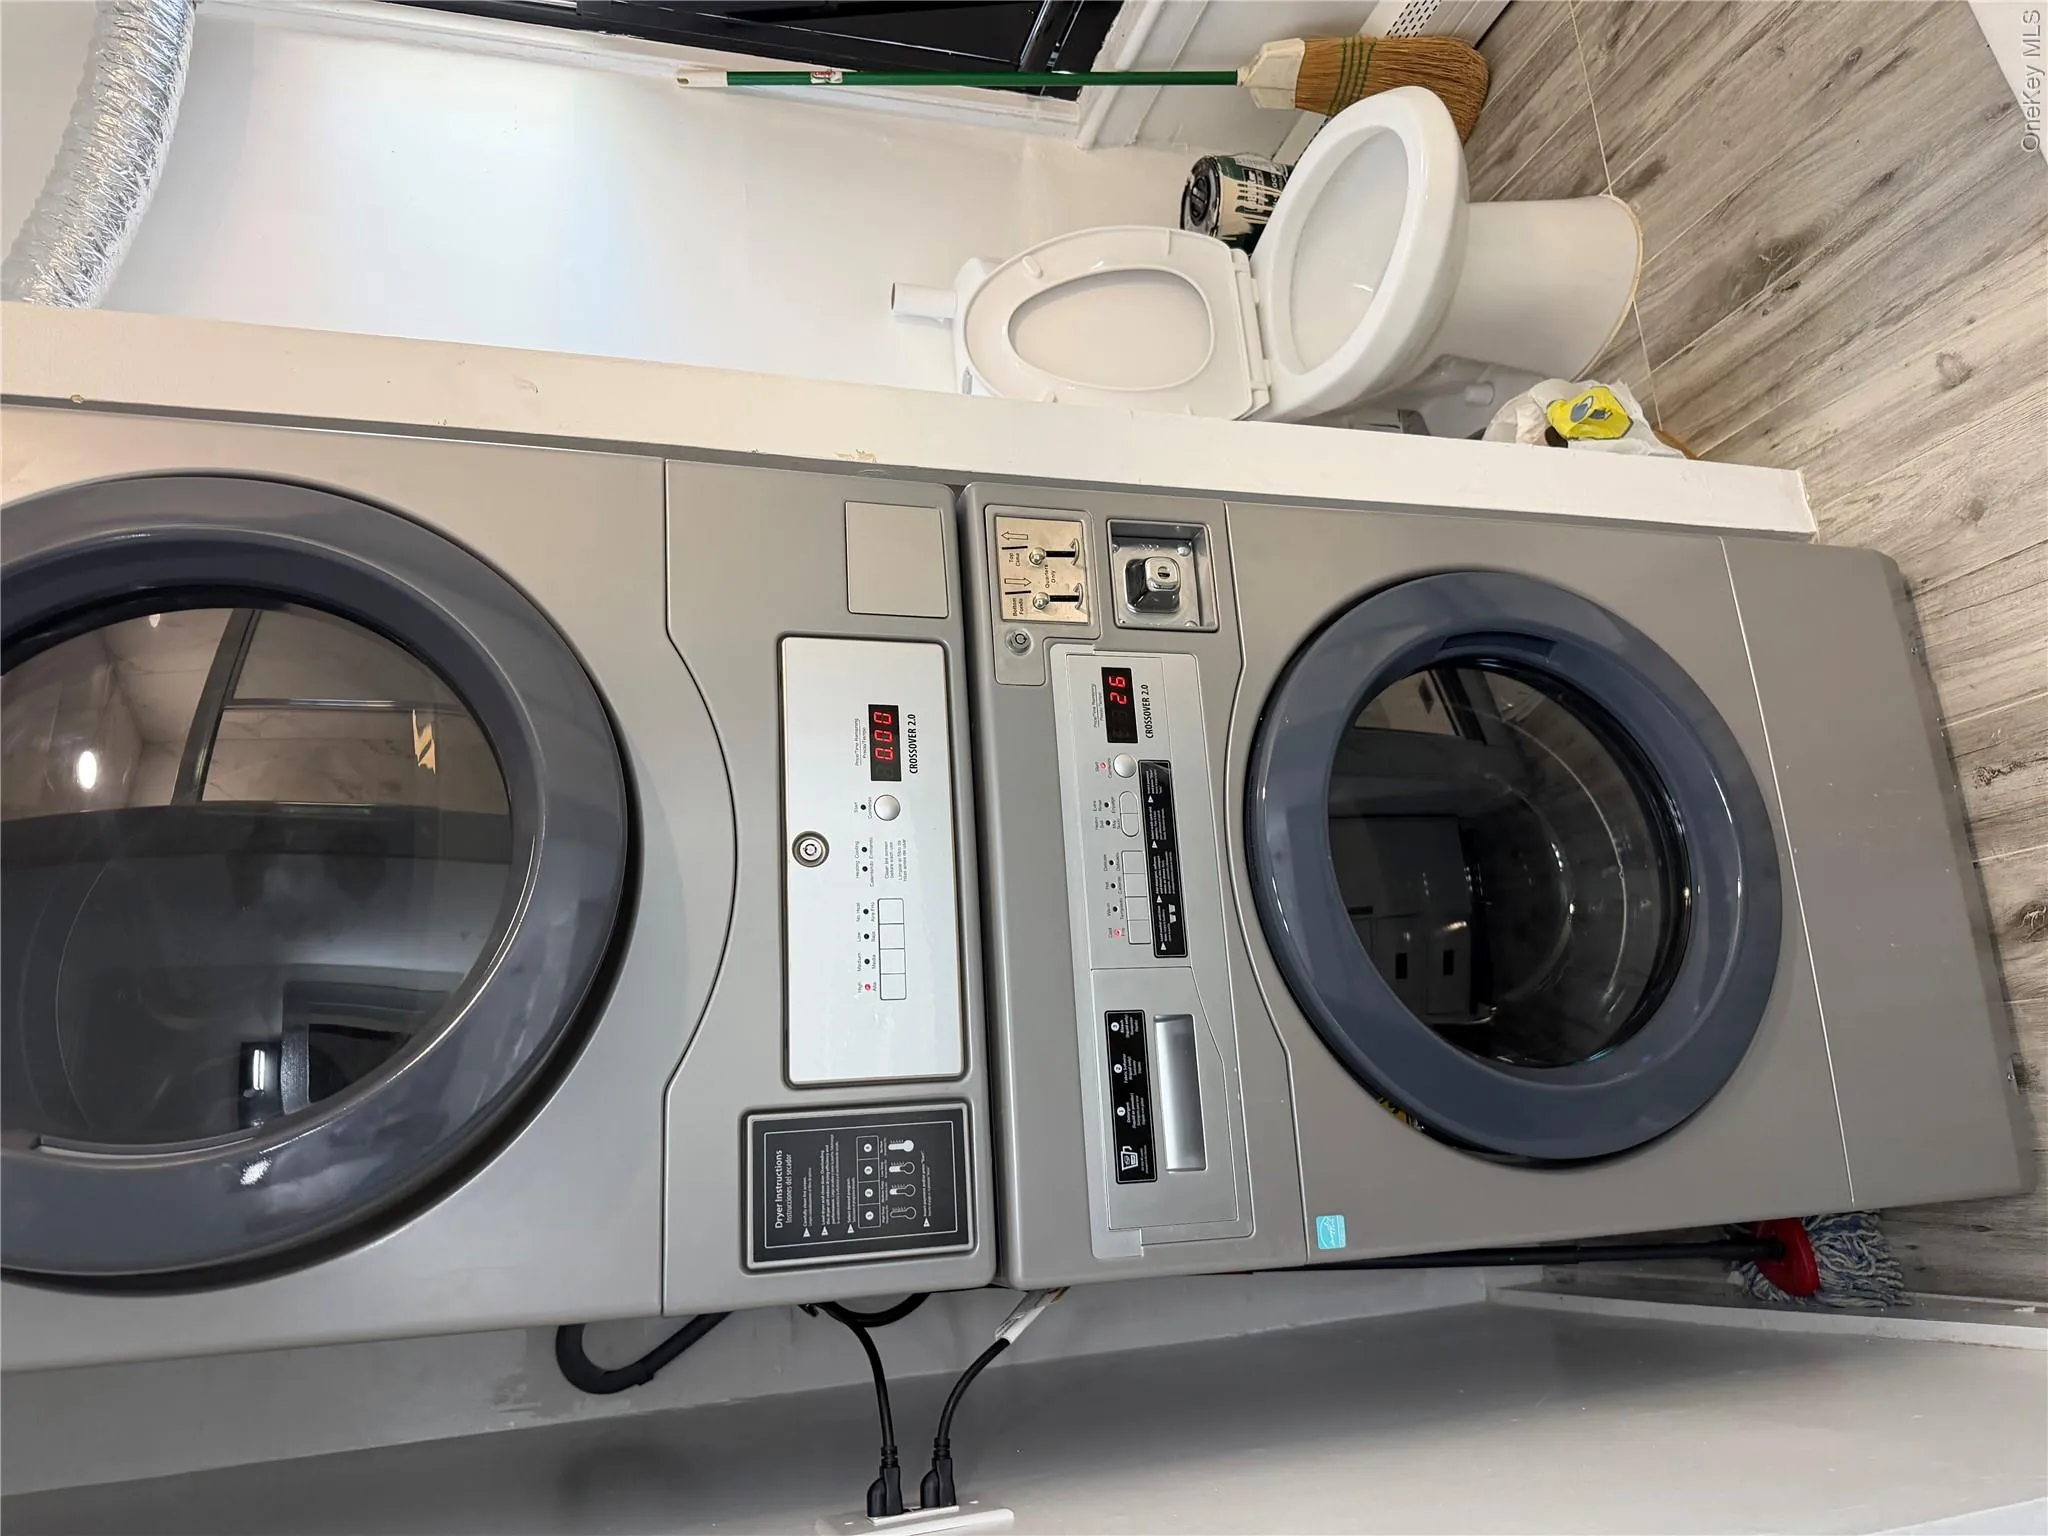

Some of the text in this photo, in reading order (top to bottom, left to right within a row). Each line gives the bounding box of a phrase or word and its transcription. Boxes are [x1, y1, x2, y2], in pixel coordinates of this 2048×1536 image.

[1108, 675, 1127, 705] 26
[1141, 684, 1154, 738] CROSSOVER 2.0
[874, 712, 894, 760] 0.00
[907, 714, 918, 774] CROSSOVER 2.0
[774, 1150, 784, 1228] Dryer Instructions
